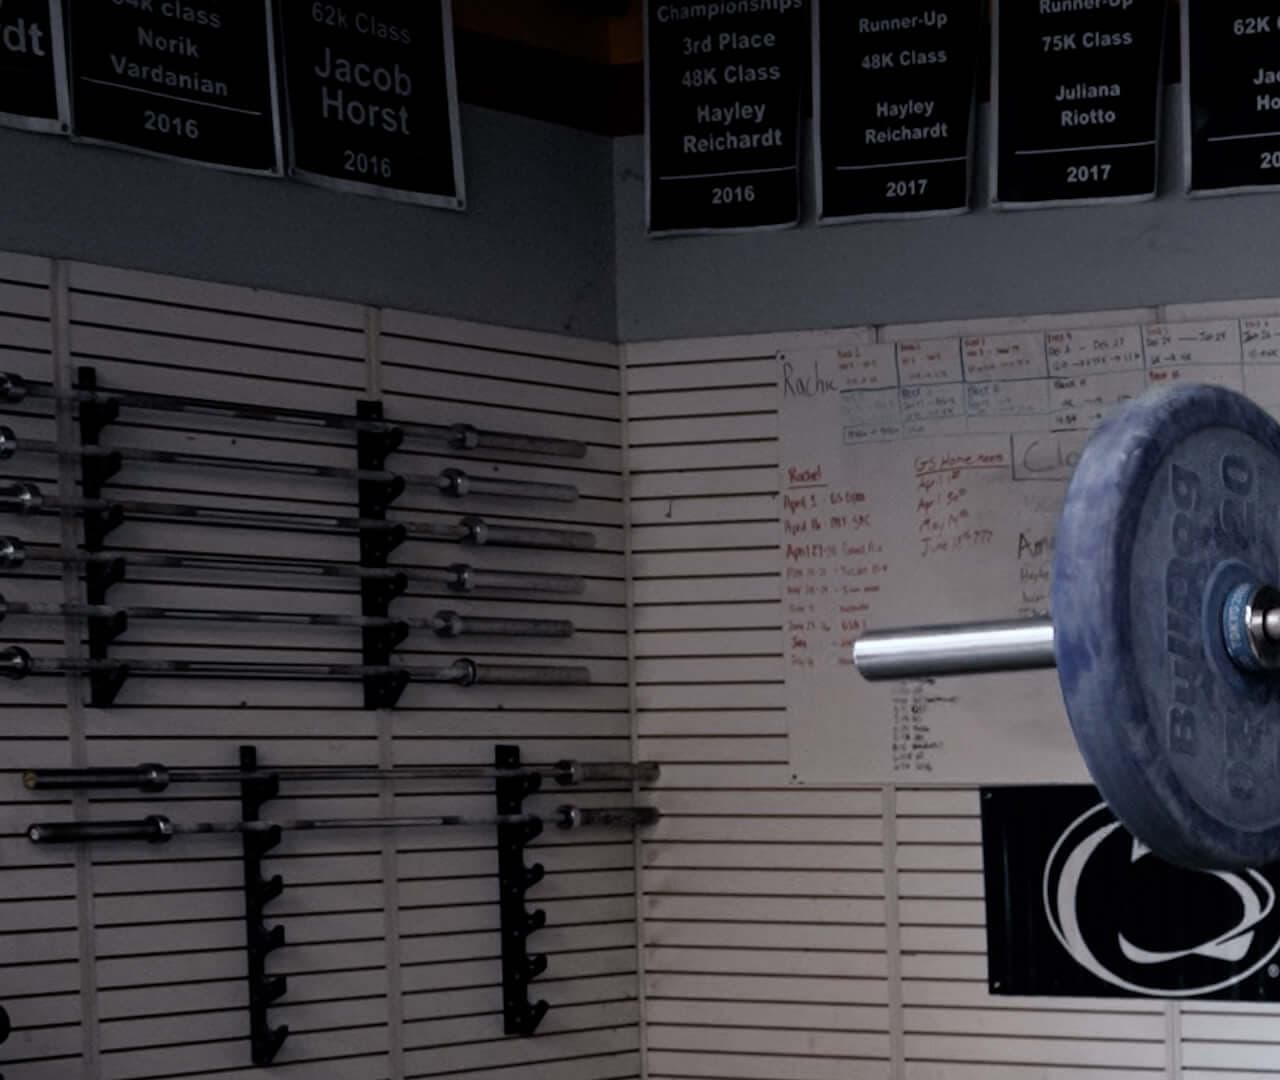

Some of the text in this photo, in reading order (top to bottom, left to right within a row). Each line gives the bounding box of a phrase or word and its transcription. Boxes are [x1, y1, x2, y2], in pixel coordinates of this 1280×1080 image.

[311, 1, 411, 45] 62k Class
[656, 0, 803, 23] Championships
[858, 10, 948, 33] Runner-Up
[0, 15, 48, 58] dt
[1233, 15, 1271, 36] 62K
[137, 26, 199, 58] Norik
[683, 32, 776, 56] 3rd Place
[1041, 31, 1133, 52] 75K Class
[861, 49, 948, 70] 48K Class
[109, 53, 229, 97] Vardanian
[313, 47, 414, 97] Jacob
[681, 64, 781, 88] 48K Class
[1055, 83, 1121, 102] Juliana
[321, 83, 412, 136] Horst
[697, 101, 766, 126] Hayley
[876, 99, 935, 120] Hayley
[1061, 108, 1116, 127] Riotto
[144, 110, 199, 139] 2016
[865, 122, 948, 145] Reichardt
[683, 127, 783, 153] Reichardt
[343, 149, 392, 179] 2016
[1066, 164, 1112, 183] 2017
[711, 185, 755, 205] 2016
[885, 178, 928, 198] 2017
